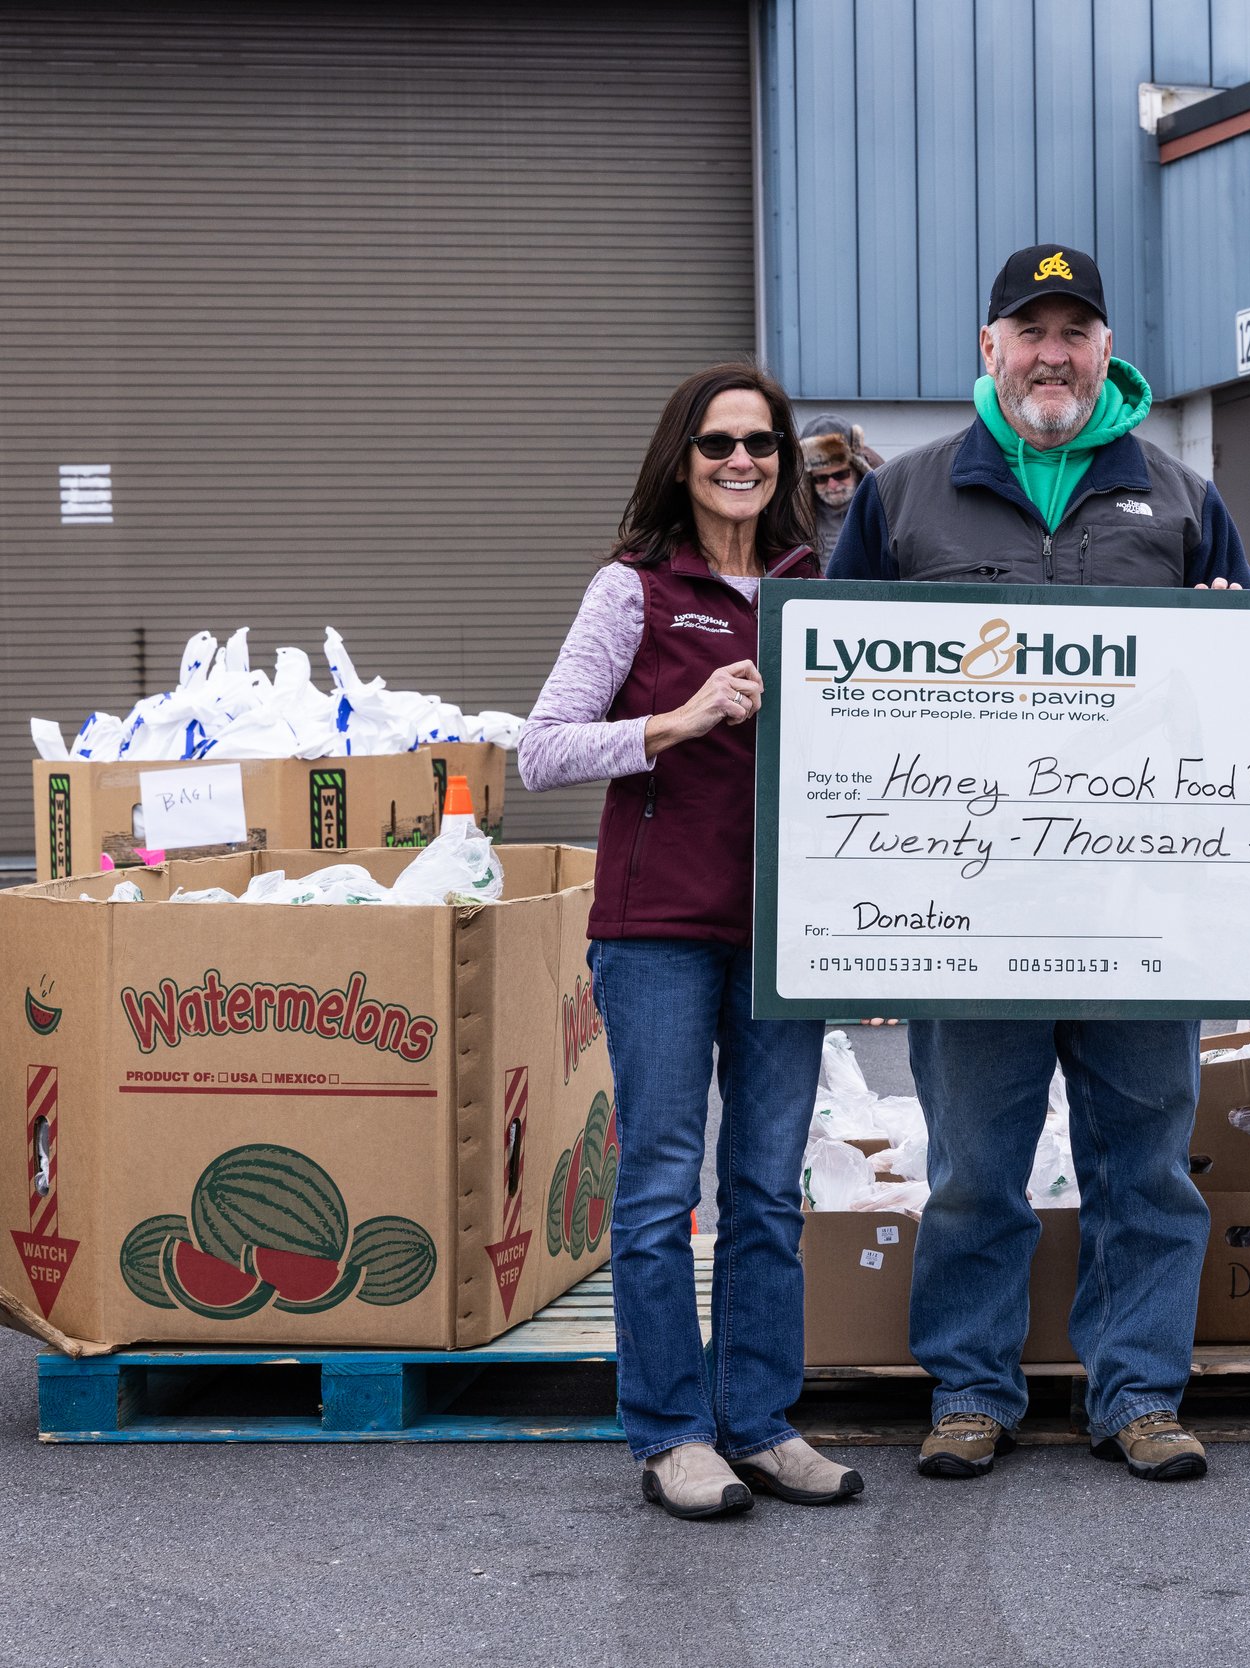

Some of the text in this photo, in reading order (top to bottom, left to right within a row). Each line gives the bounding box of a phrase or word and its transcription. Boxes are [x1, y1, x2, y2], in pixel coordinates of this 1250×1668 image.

[822, 685, 1116, 708] site contractors paving
[831, 707, 1110, 722] Pride In Our People. Pride In Our Work.
[807, 770, 873, 786] Pay to the
[881, 752, 1009, 816] Honey
[1028, 756, 1156, 800] Brook
[1175, 758, 1236, 800] Food
[156, 789, 200, 812] BAG
[806, 788, 861, 801] order of:
[55, 800, 64, 867] WATCH
[853, 900, 970, 932] Donation
[804, 924, 830, 937] For:
[1141, 959, 1162, 973] 90
[120, 968, 438, 1062] Watermelons
[126, 1070, 327, 1085] PRODUCT OF: USA MEXICO
[22, 1242, 68, 1264] WATCH
[495, 1242, 526, 1268] WATCH
[30, 1264, 61, 1284] STEP
[499, 1265, 520, 1287] STEP
